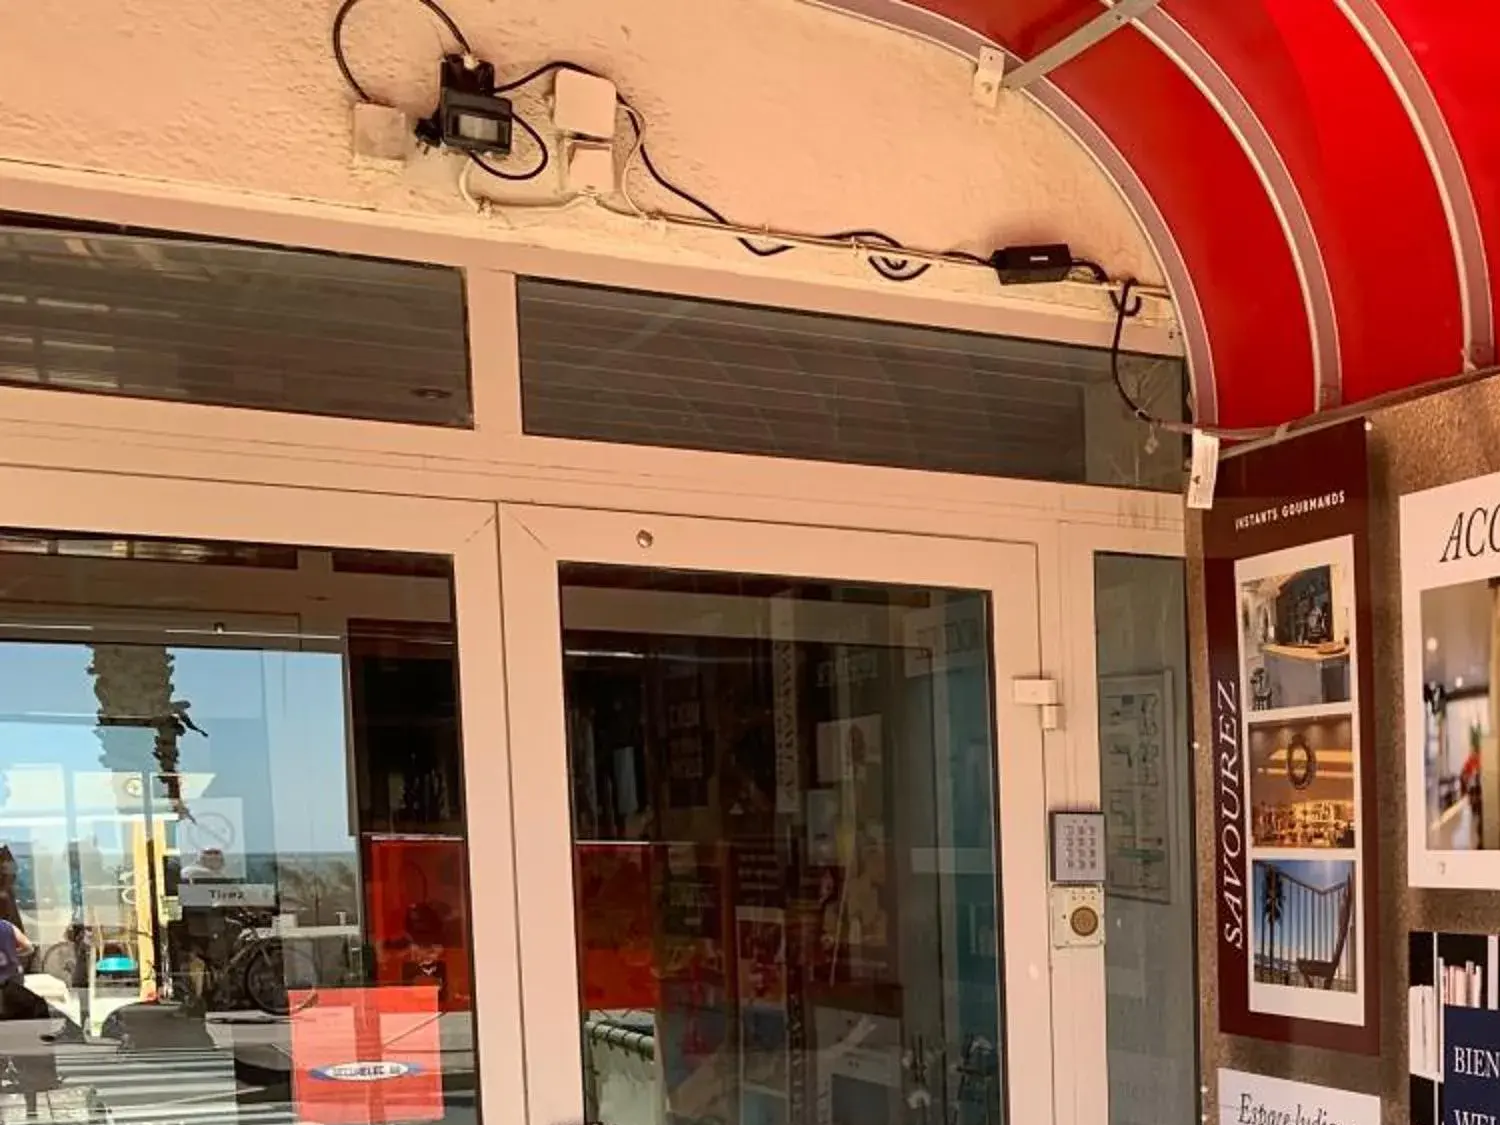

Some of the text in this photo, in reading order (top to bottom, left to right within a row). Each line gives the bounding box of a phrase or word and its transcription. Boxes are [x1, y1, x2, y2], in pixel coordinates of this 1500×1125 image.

[1235, 489, 1345, 532] INSTANTS GOURMANDS
[1217, 679, 1244, 950] SAVOUREZ
